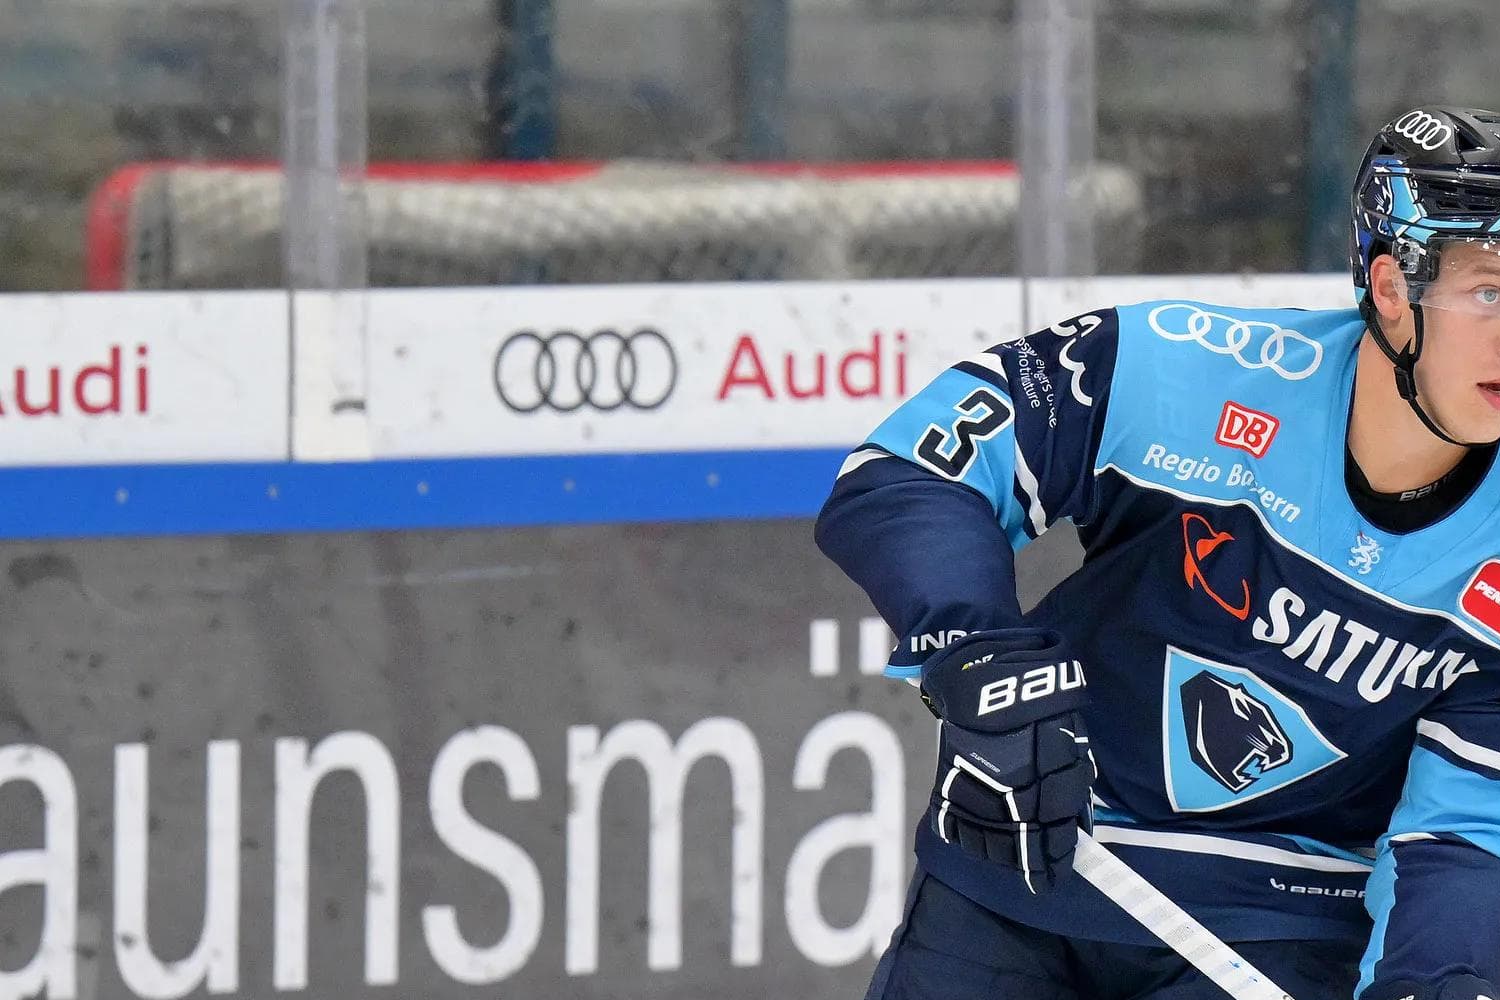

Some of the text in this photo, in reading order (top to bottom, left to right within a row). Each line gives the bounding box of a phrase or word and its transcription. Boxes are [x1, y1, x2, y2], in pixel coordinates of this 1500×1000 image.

[0, 343, 149, 416] udi
[717, 331, 906, 401] Audi
[913, 386, 1015, 482] 3
[1143, 443, 1221, 483] Regio
[978, 660, 1087, 716] BAU
